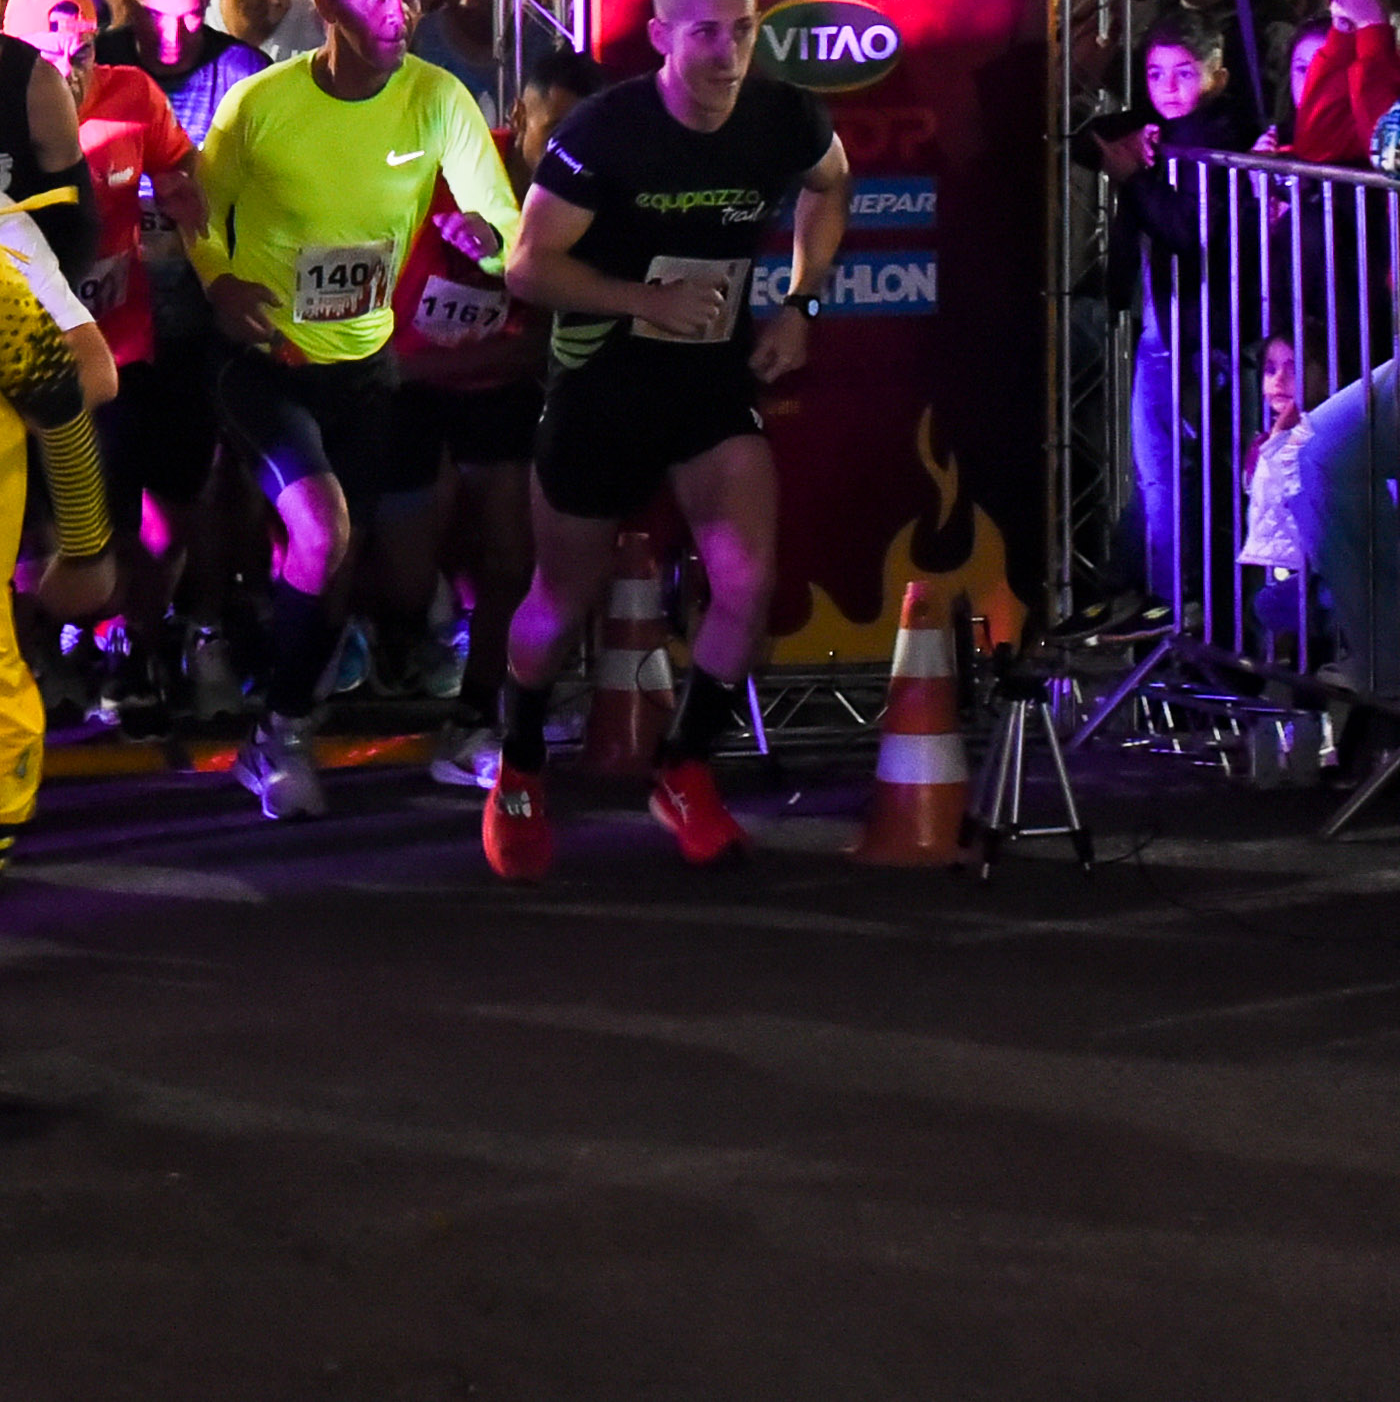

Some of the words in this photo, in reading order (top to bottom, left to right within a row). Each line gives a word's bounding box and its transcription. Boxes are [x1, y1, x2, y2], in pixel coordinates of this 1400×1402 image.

[721, 200, 765, 226] trail
[848, 191, 938, 214] NEPAR
[422, 297, 500, 326] 1167
